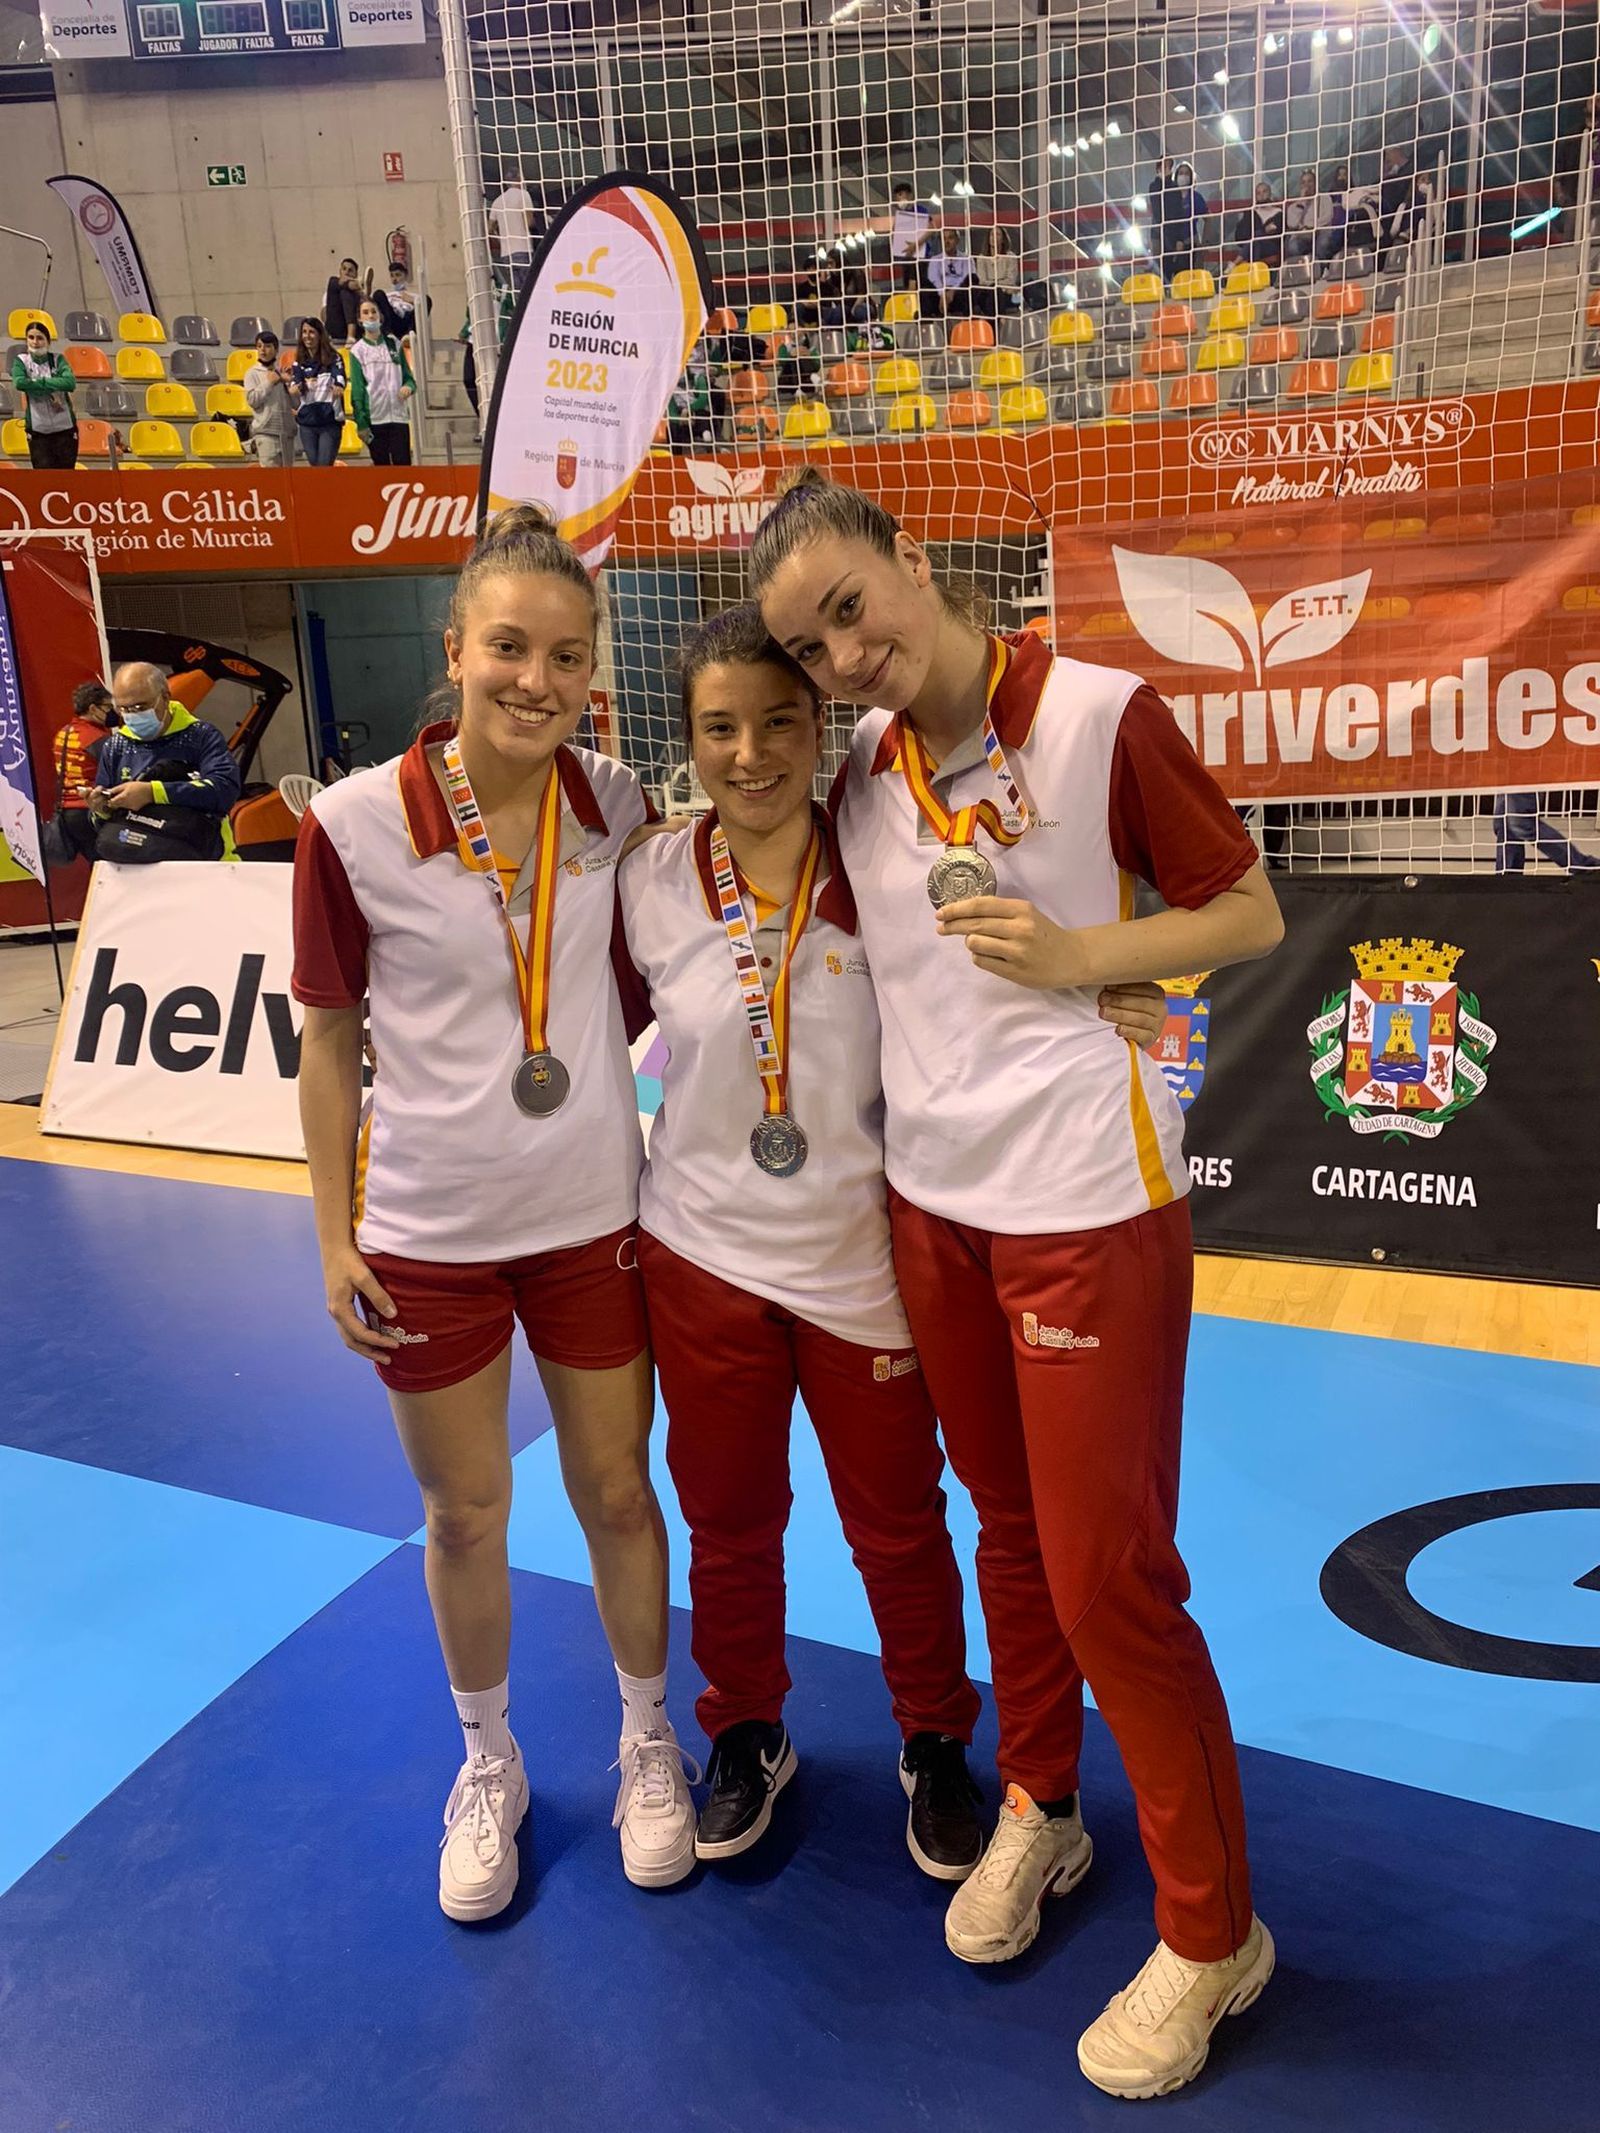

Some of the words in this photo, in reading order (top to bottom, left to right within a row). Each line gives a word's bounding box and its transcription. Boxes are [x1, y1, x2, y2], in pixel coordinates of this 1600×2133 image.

[349, 9, 413, 24] Deportes
[52, 23, 118, 38] Deportes
[291, 34, 326, 47] FALTAS
[147, 41, 182, 54] FALTAS
[198, 38, 238, 51] JUGADOR
[245, 36, 275, 49] FALTAS
[550, 309, 615, 332] REGIÓN
[548, 333, 571, 351] DE
[573, 336, 640, 359] MURCIA
[546, 358, 609, 394] 2023
[544, 395, 573, 409] Capital
[573, 398, 607, 412] mundial
[606, 401, 617, 413] de
[544, 409, 555, 418] los
[555, 411, 589, 423] deportes
[589, 414, 600, 424] de
[600, 417, 620, 427] agua
[524, 449, 554, 465] Región
[580, 456, 591, 467] de
[594, 458, 625, 473] Murcia
[1231, 466, 1330, 504] Natural
[1334, 460, 1423, 498] Quality
[41, 491, 153, 525] Costa
[162, 488, 286, 523] Cálida
[64, 530, 150, 557] Región
[156, 528, 186, 549] de
[190, 526, 273, 548] Murcia
[1290, 594, 1352, 618] E.T.T.
[1038, 819, 1061, 828] León
[1308, 1022, 1324, 1035] MUY
[1323, 1012, 1343, 1028] NOBLE
[1464, 1019, 1495, 1043] SIEMPRE
[1311, 1062, 1327, 1074] MUY
[1327, 1050, 1342, 1065] LEAL
[1456, 1057, 1487, 1087] HEROICA
[1353, 1118, 1382, 1132] CIUDAD
[1382, 1116, 1393, 1127] DE
[1394, 1116, 1437, 1136] CARTAGENA
[1311, 1164, 1478, 1208] CARTAGENA
[1039, 1326, 1060, 1336] Junta
[1061, 1329, 1072, 1337] de
[1076, 1337, 1099, 1346] León
